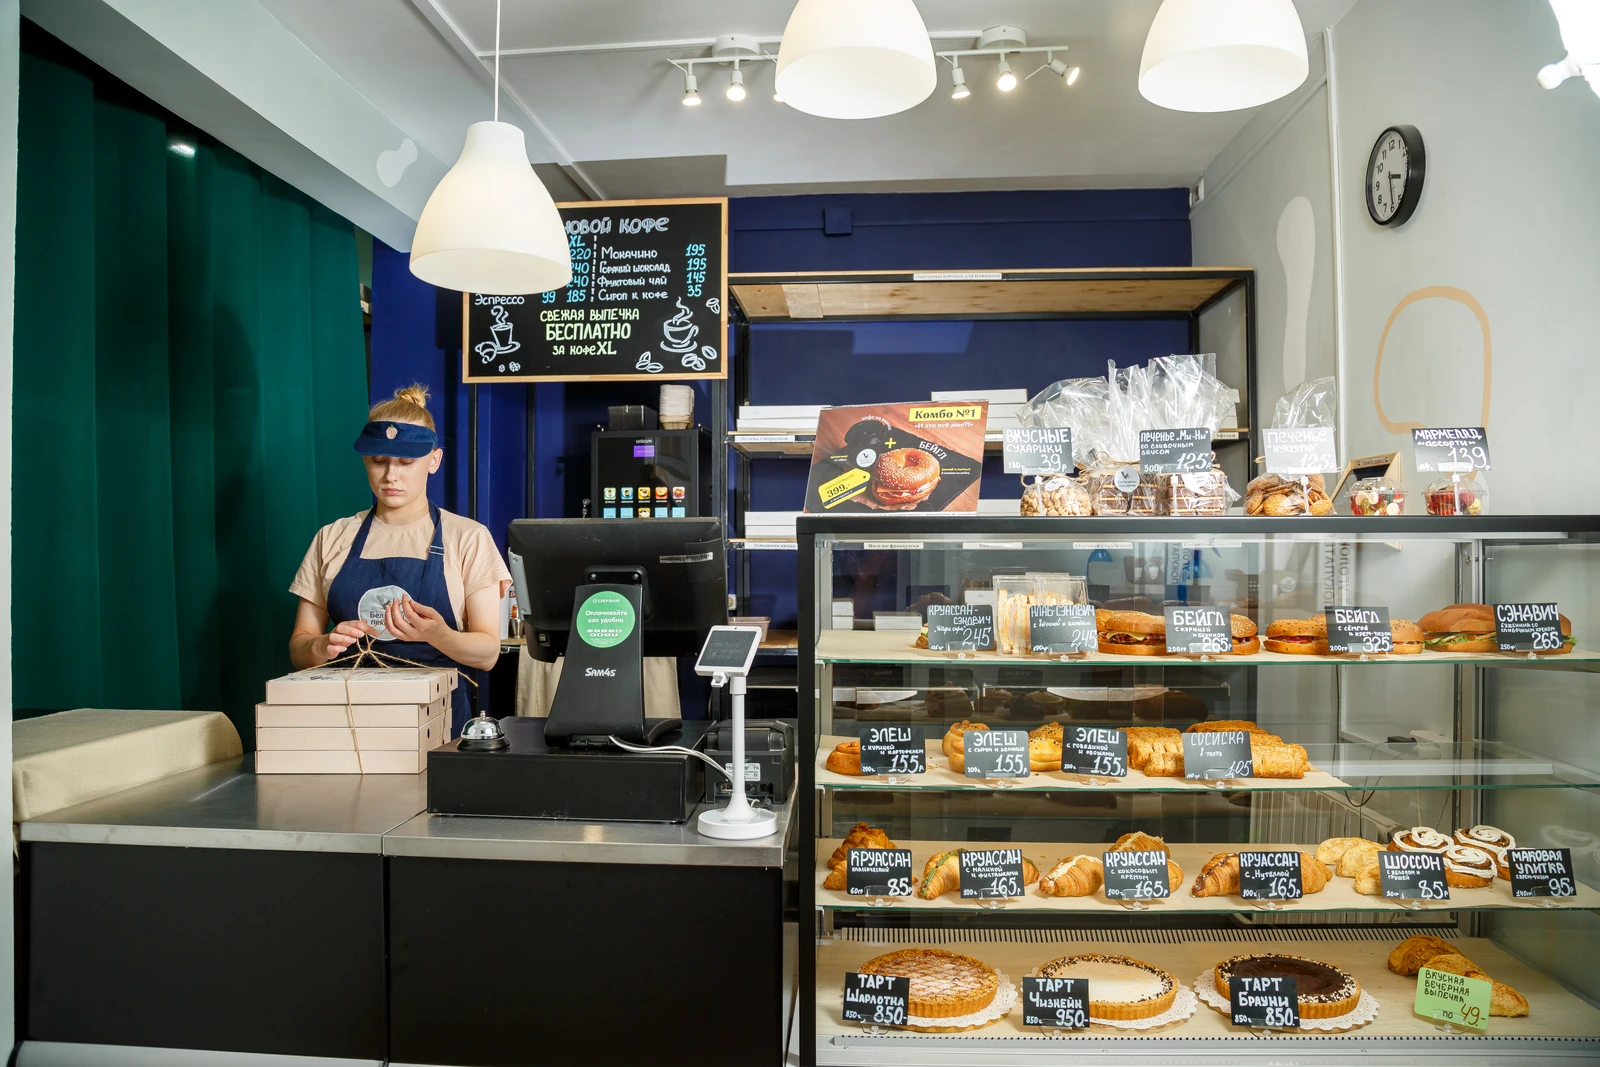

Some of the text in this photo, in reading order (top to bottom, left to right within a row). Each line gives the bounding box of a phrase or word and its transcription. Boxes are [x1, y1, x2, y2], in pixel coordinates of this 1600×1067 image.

[1388, 140, 1396, 151] 12
[1382, 150, 1386, 160] 11
[1376, 163, 1384, 174] 10
[1376, 181, 1380, 190] 9
[1378, 195, 1382, 204] 8
[1383, 203, 1388, 213] 7
[1390, 203, 1394, 212] 6
[570, 235, 586, 247] XL
[570, 248, 592, 260] 220
[686, 244, 706, 256] 195
[632, 263, 671, 272] шоколад
[686, 258, 706, 270] 195
[597, 276, 645, 287] Фруктовый
[686, 272, 706, 284] 145
[566, 290, 586, 302] 185
[598, 289, 628, 300] Сироп
[687, 284, 702, 297] 35
[474, 294, 524, 305] Эспрессо
[540, 308, 640, 322] СВЕЖАЯ ВЫПЕЧКА
[546, 324, 631, 341] БЕСПЛАТНО
[570, 345, 596, 356] кофе
[596, 341, 617, 355] XL
[915, 408, 976, 420] Комбо №1
[1006, 429, 1069, 443] ВКУСНЫЕ
[1141, 432, 1175, 442] ПЕЧЕНЬЕ
[1268, 431, 1328, 443] ПЕЧЕНЬЕ
[1415, 429, 1482, 440] МАРМЕЛАД
[919, 440, 948, 460] БЕЙГЛ
[1006, 444, 1062, 453] СУХАРИКИ
[929, 605, 978, 615] КРУАССАН-
[1335, 609, 1380, 624] БЕЙГЛ
[1497, 605, 1559, 622] СЭНДВИЧ
[954, 616, 991, 626] СЭНДВИЧ
[1173, 609, 1225, 626] БЕЙГЛ
[963, 627, 991, 646] 245
[1071, 629, 1098, 648] 245
[870, 727, 911, 743] ЭЛЕШ
[973, 732, 1017, 746] ЭЛЕШ
[1076, 727, 1119, 744] ЭЛЕШ
[1191, 731, 1244, 746] СОСИСКА
[1225, 760, 1252, 777] 105
[851, 851, 911, 867] КРУАССАН
[962, 849, 1021, 867] КРУАССАН
[1106, 851, 1165, 867] КРУАССАН
[1240, 853, 1298, 867] КРУАССАН
[1384, 854, 1440, 870] ШОССОН
[1512, 850, 1562, 862] МАКОВАЯ
[978, 871, 1018, 879] ФИСТАШКАМИ
[1515, 862, 1566, 874] УЛИТКА
[858, 974, 896, 990] ТАРТ
[1241, 977, 1282, 991] ТАРТ
[1425, 970, 1464, 985] ВКУСНАЯ
[1036, 979, 1074, 992] ТАРТ
[846, 988, 904, 1007] Шарлотка
[1029, 992, 1082, 1008] Чизкейк
[1238, 992, 1289, 1007] Брауни
[1424, 988, 1464, 1003] ВЫПЕЧКА
